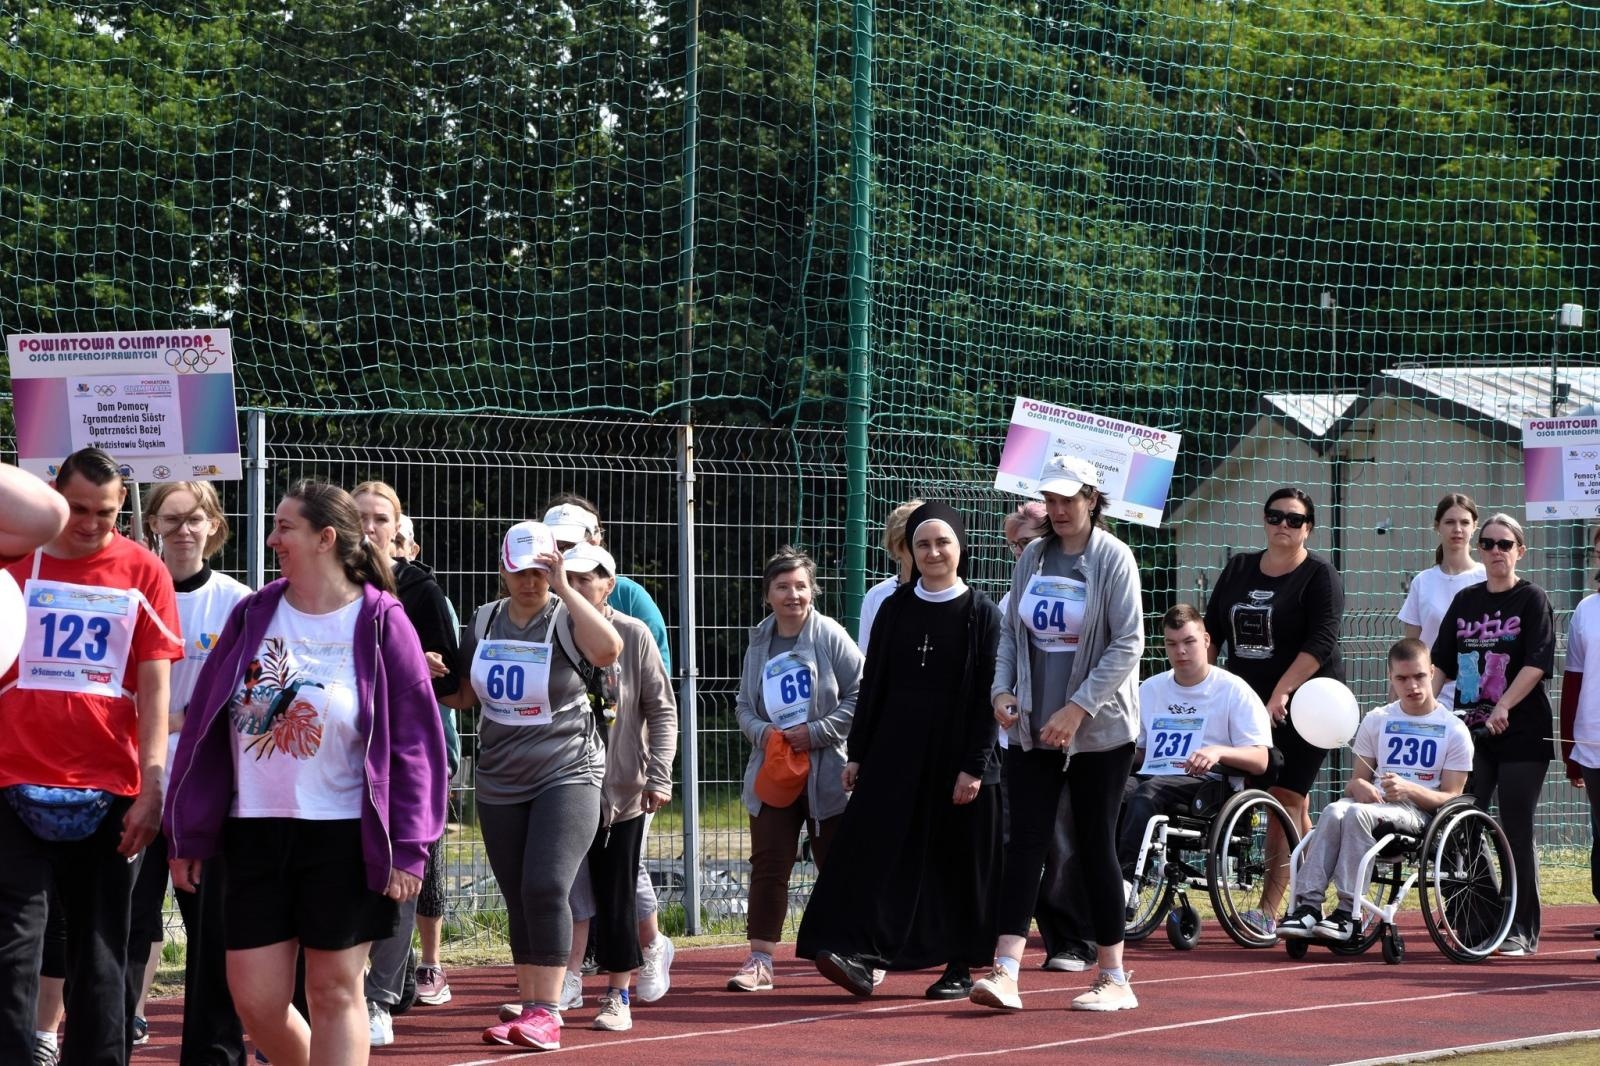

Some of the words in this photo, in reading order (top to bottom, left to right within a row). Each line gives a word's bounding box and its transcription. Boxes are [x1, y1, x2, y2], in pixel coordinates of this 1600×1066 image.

[19, 337, 115, 352] POWIATOWA
[118, 335, 203, 350] OLIMPIADA
[58, 351, 158, 361] NIEPEŁNOSPRAWNYCH
[97, 402, 115, 412] Dom
[117, 401, 149, 412] Pomocy
[82, 414, 140, 426] Zgromadzenia
[141, 413, 166, 422] Sióstr
[1022, 401, 1095, 425] POWIATOWA
[1096, 419, 1160, 441] OLIMPIADA
[1530, 419, 1598, 430] POWIATOWA
[89, 424, 138, 437] Opatrzności
[139, 424, 161, 436] Bożej
[94, 441, 136, 449] Wodzisławiu
[138, 438, 166, 449] Śląskim
[1033, 600, 1066, 632] 64
[40, 613, 110, 661] 123
[487, 664, 524, 701] 60
[780, 670, 811, 704] 68
[1153, 732, 1193, 758] 231
[1386, 736, 1437, 768] 230
